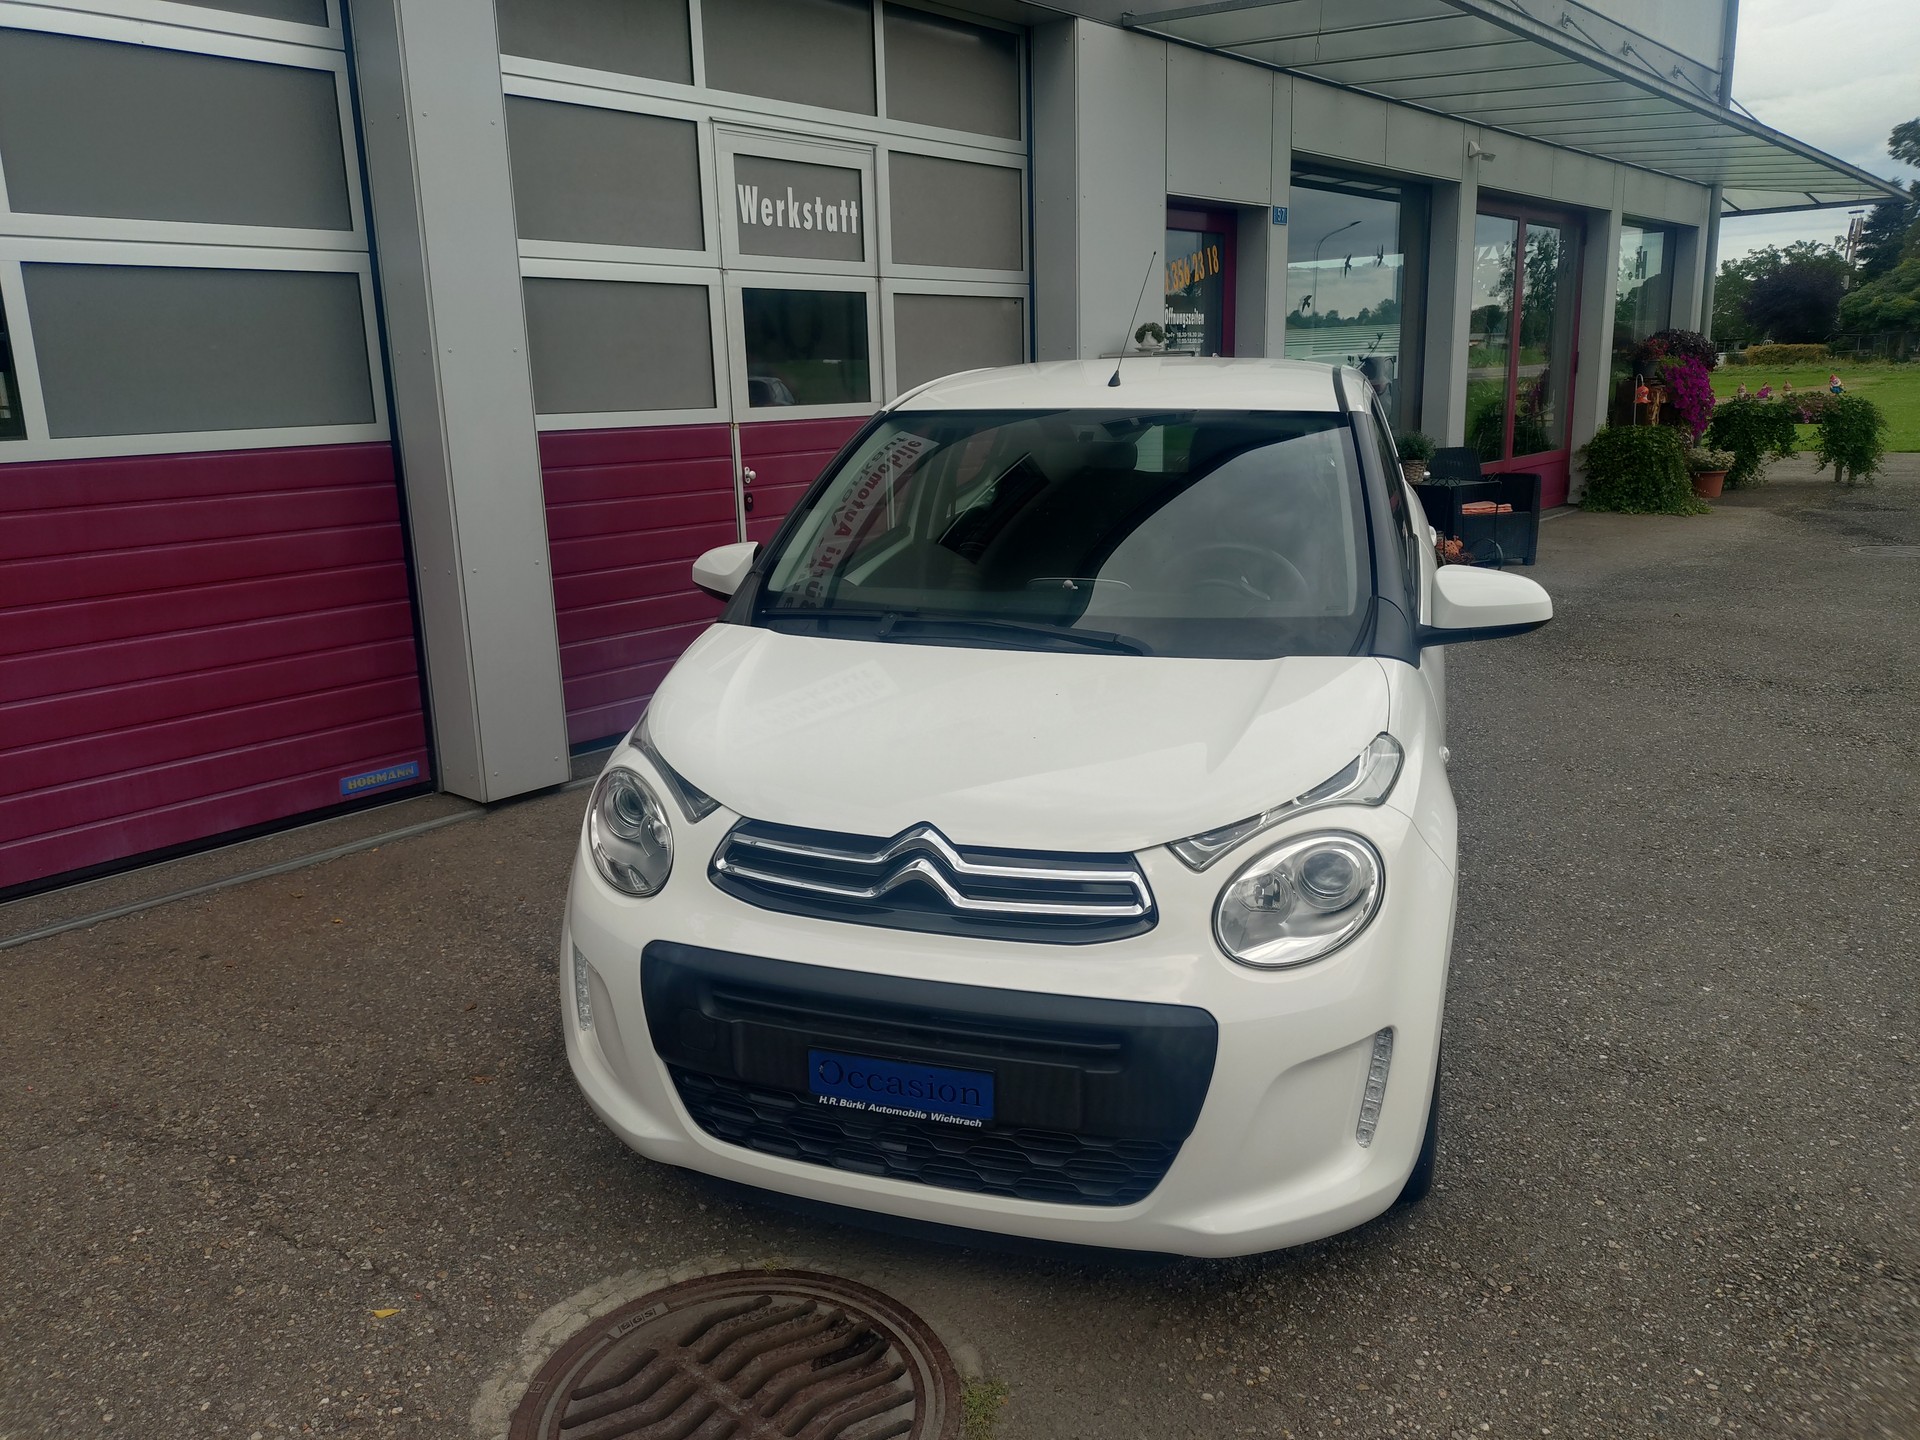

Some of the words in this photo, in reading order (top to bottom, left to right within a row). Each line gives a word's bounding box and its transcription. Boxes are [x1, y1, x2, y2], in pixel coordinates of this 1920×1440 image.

[737, 183, 858, 234] Werkstatt
[1277, 208, 1285, 222] 57
[1171, 258, 1190, 289] 356
[1192, 251, 1205, 282] 23
[1207, 244, 1219, 275] 18
[818, 1059, 983, 1107] Occasion
[867, 1103, 927, 1120] Automobile
[930, 1112, 983, 1128] Wichtrach
